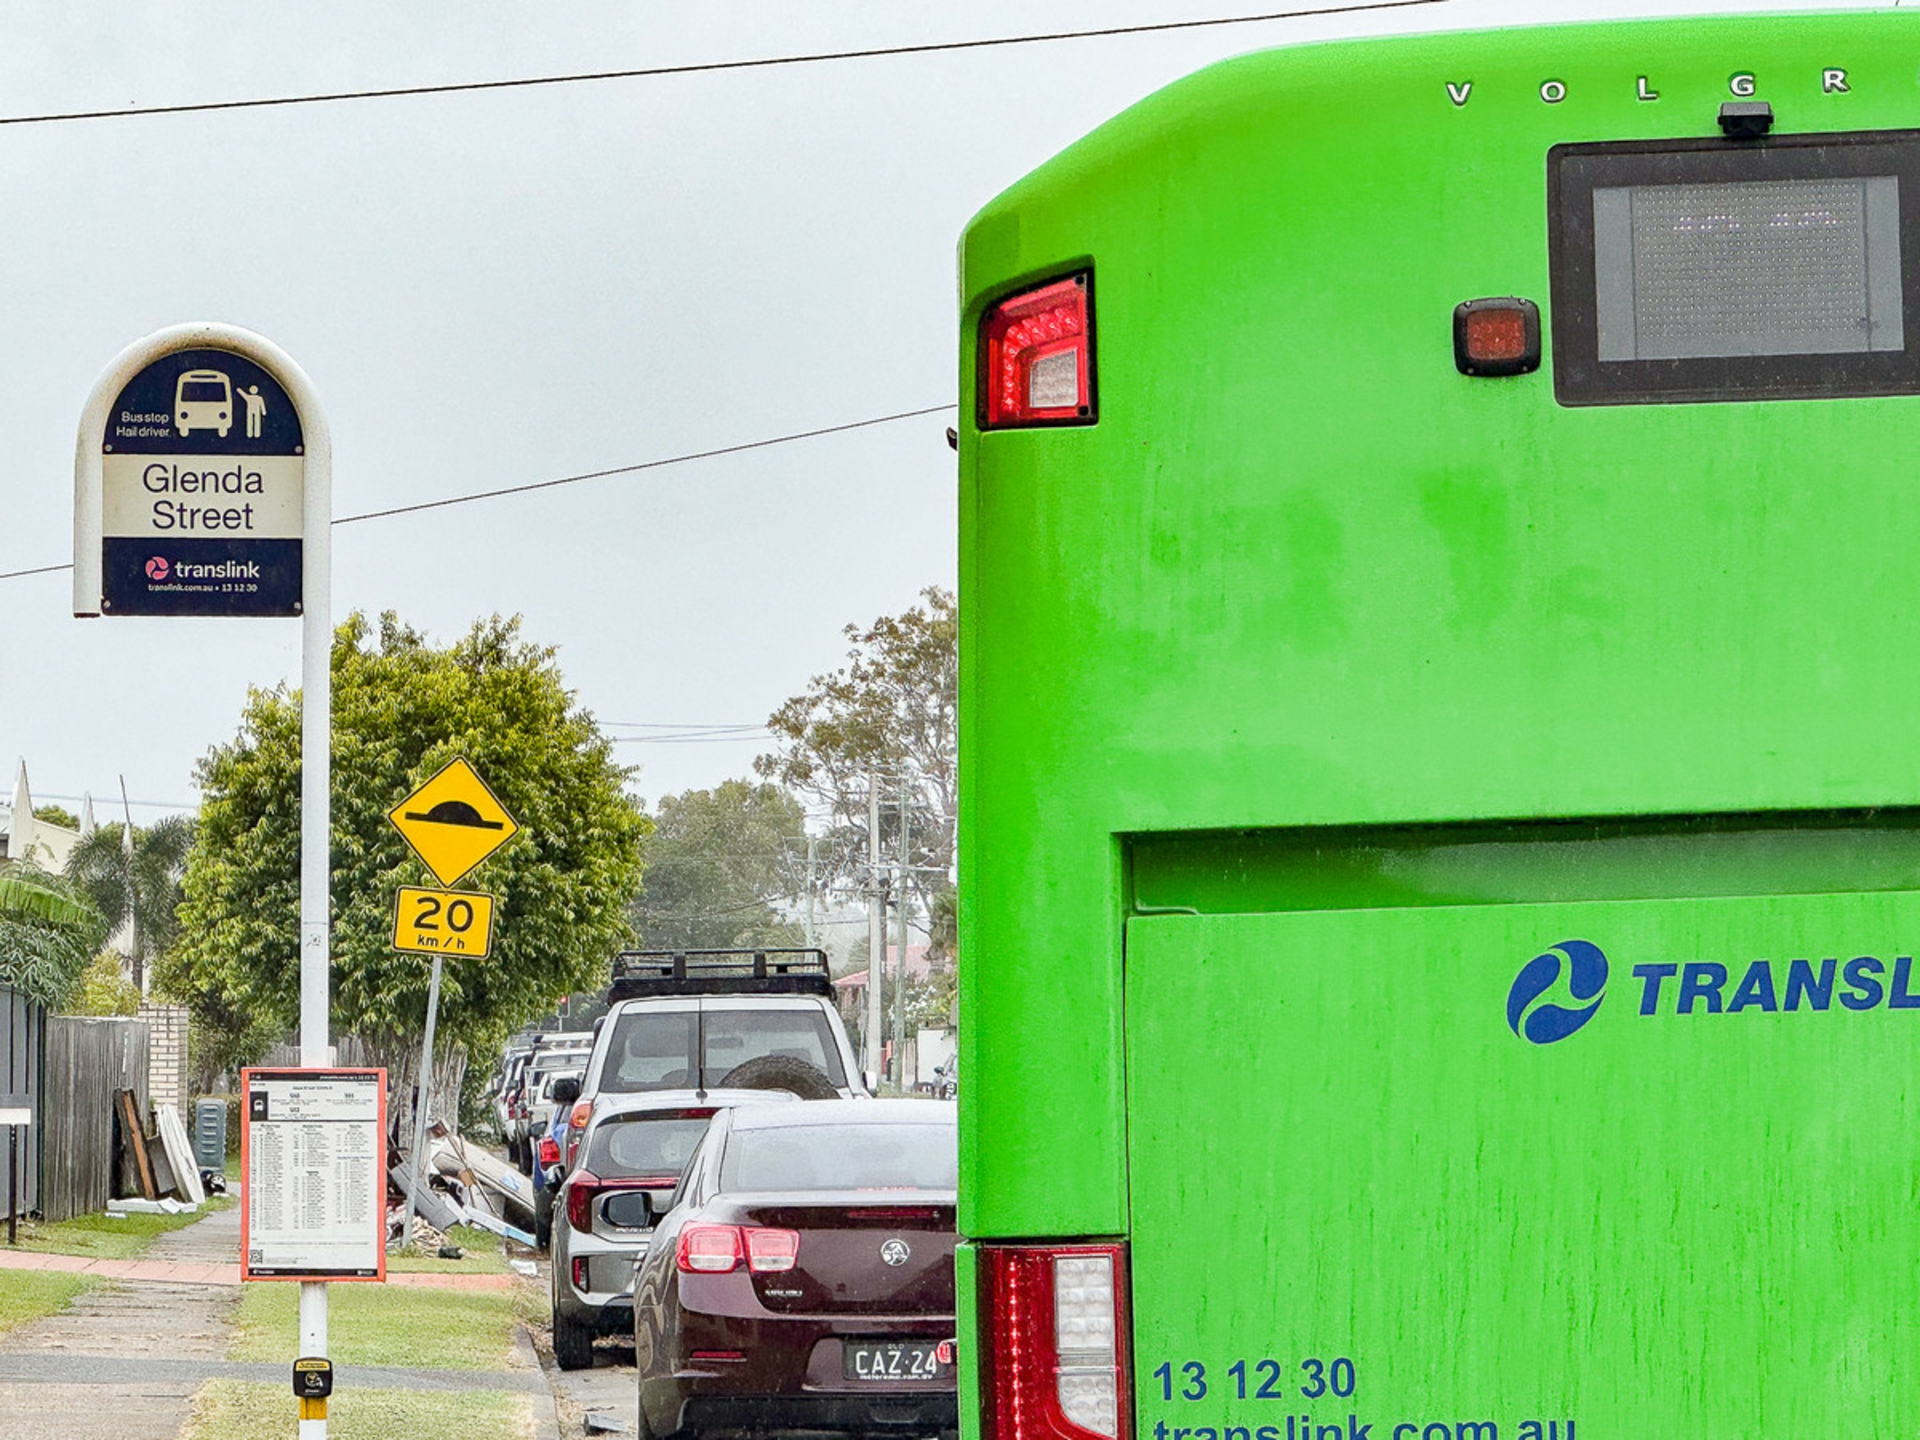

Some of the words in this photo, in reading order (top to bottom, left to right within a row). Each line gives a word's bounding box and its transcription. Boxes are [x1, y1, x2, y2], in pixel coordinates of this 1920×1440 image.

[116, 426, 138, 437] Hail
[138, 426, 170, 437] driver
[121, 411, 143, 422] Bus
[144, 412, 169, 424] stop
[143, 464, 264, 494] Glenda
[152, 500, 254, 530] Street
[174, 560, 260, 579] translink
[222, 583, 233, 592] 13
[234, 583, 245, 592] 12
[246, 583, 258, 592] 30
[414, 897, 474, 933] 20
[1632, 956, 1920, 1016] TRANSL
[1153, 1362, 1207, 1401] 13
[1228, 1360, 1281, 1399] 12
[1301, 1358, 1355, 1399] 30
